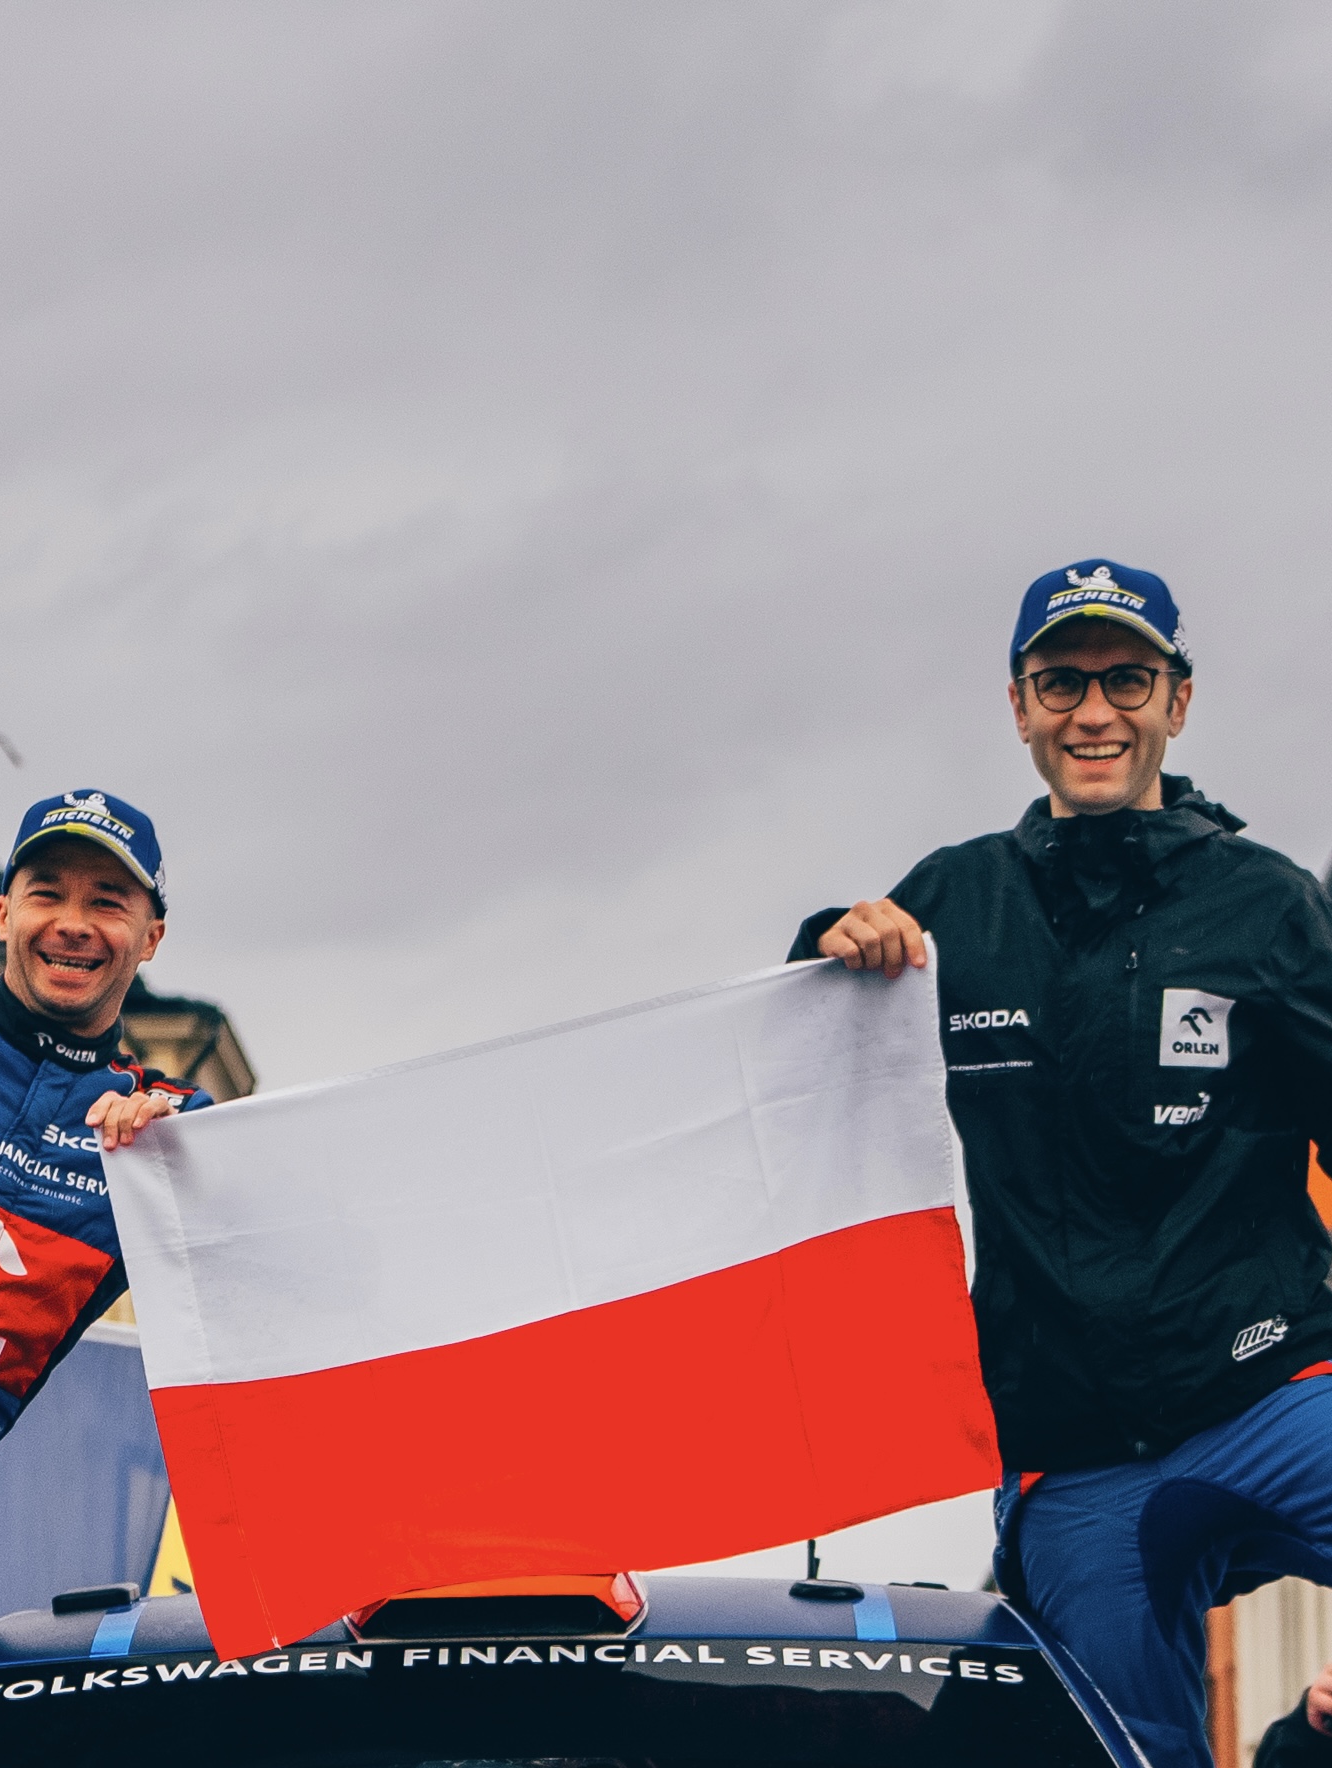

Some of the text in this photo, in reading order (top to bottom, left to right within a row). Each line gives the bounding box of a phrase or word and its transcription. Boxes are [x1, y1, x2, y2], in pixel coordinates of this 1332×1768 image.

[1046, 590, 1145, 611] MICHELIN
[40, 811, 132, 841] MICHELIN
[56, 1043, 96, 1063] ORLEN
[1172, 1041, 1219, 1055] ORLEN
[65, 1171, 109, 1197] SERV
[403, 1643, 725, 1668] FINANCIAL
[747, 1645, 1025, 1684] SERVICES
